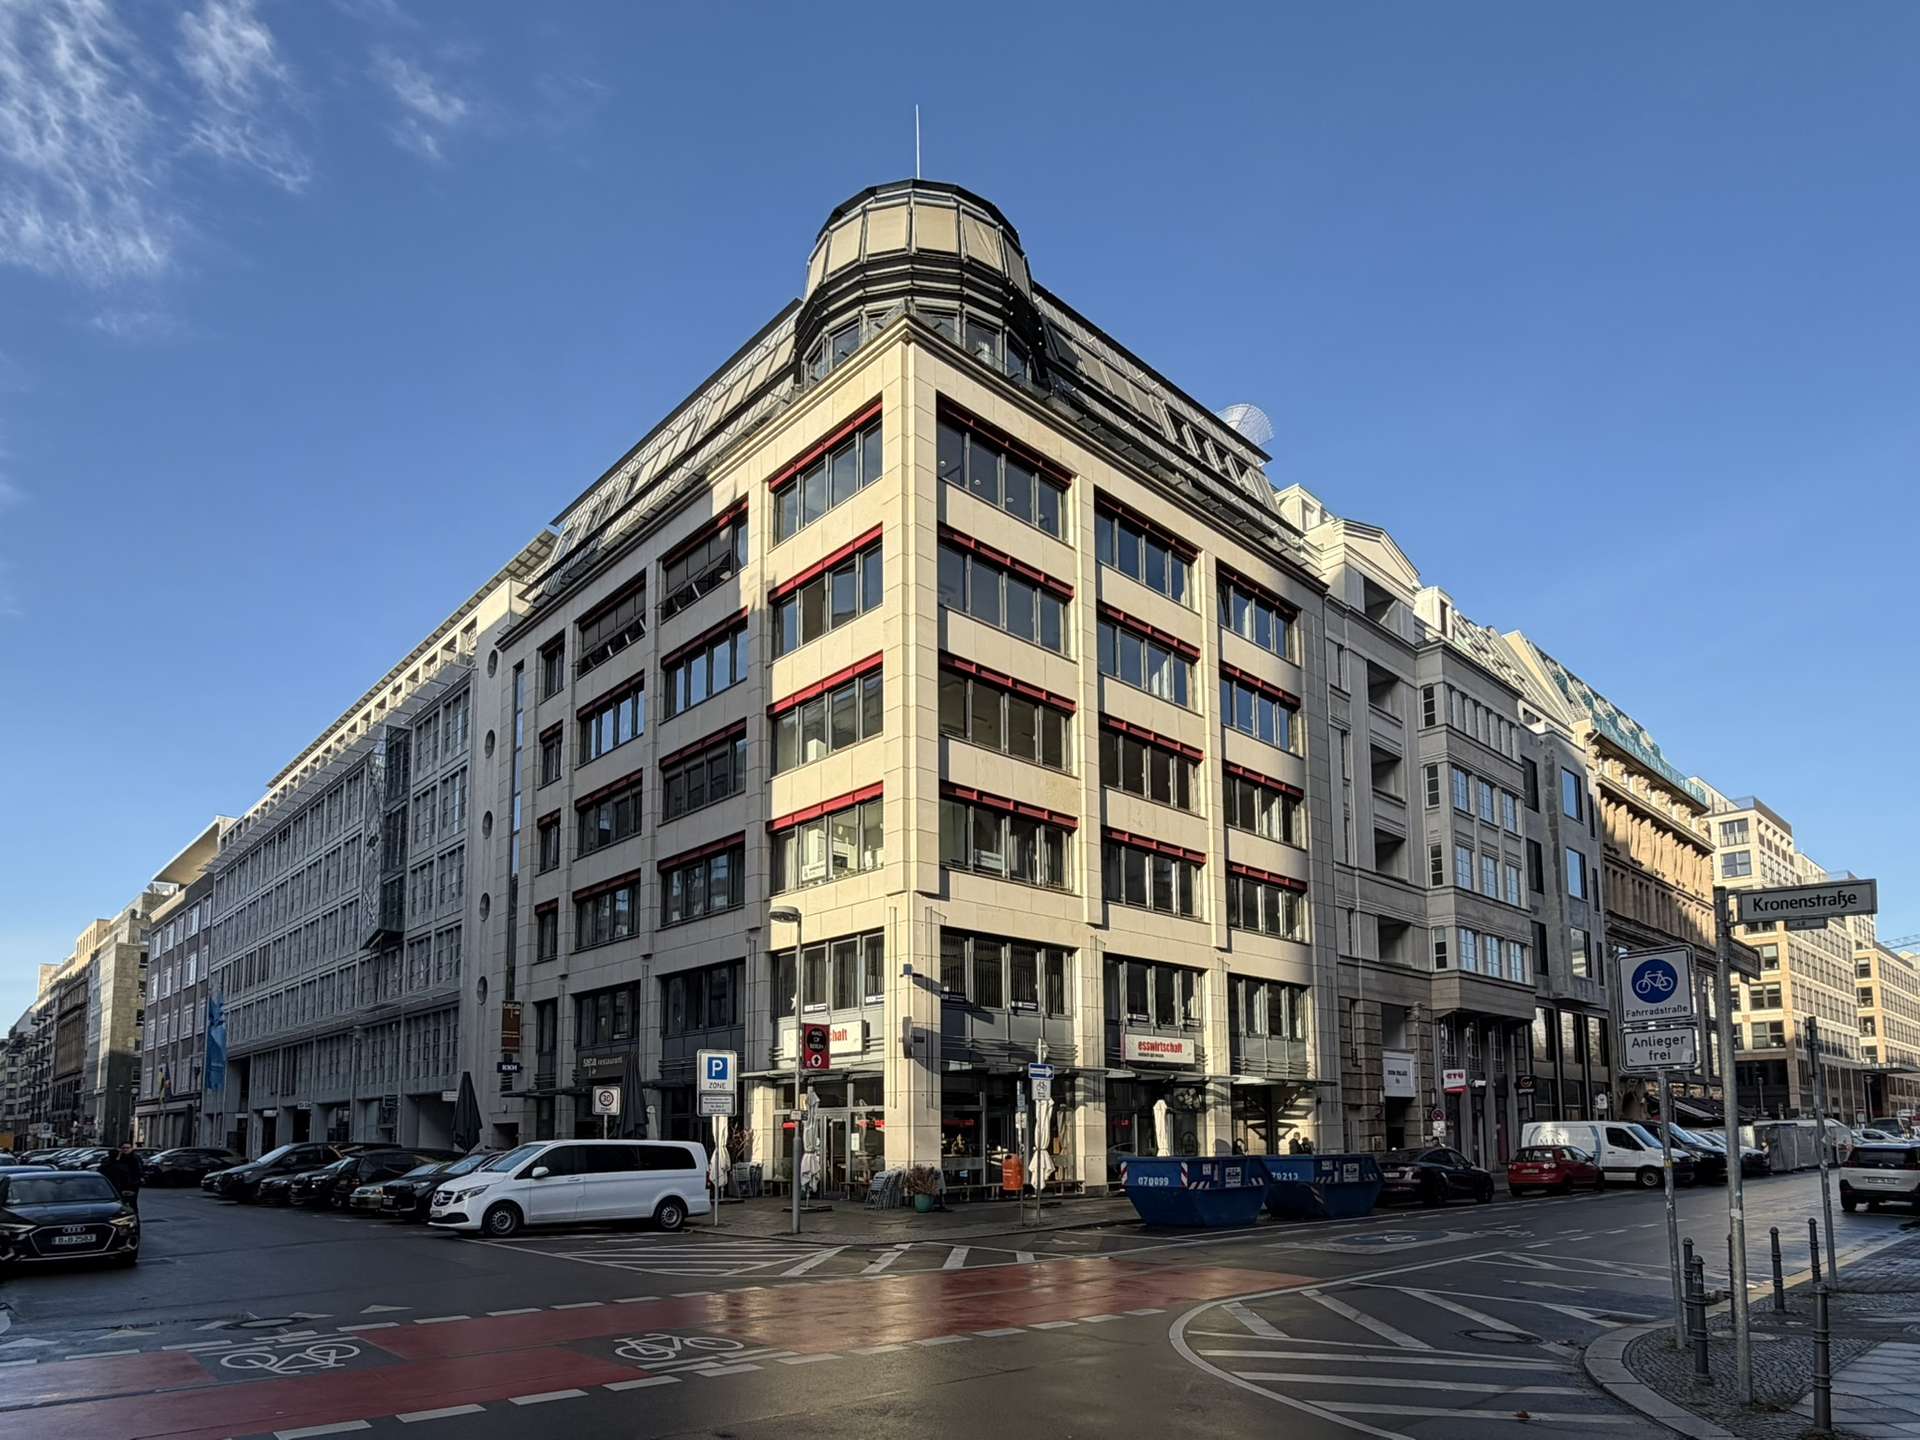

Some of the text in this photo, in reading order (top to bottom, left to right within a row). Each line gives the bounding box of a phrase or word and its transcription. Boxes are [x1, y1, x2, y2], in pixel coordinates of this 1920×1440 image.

[1753, 890, 1857, 912] Kronenstraße
[1625, 1004, 1687, 1018] Fahrradstraße
[1631, 1034, 1685, 1047] Anlieger
[1648, 1047, 1670, 1060] frei
[711, 1059, 724, 1077] P
[601, 1094, 611, 1102] 30
[1138, 1176, 1169, 1187] 070099
